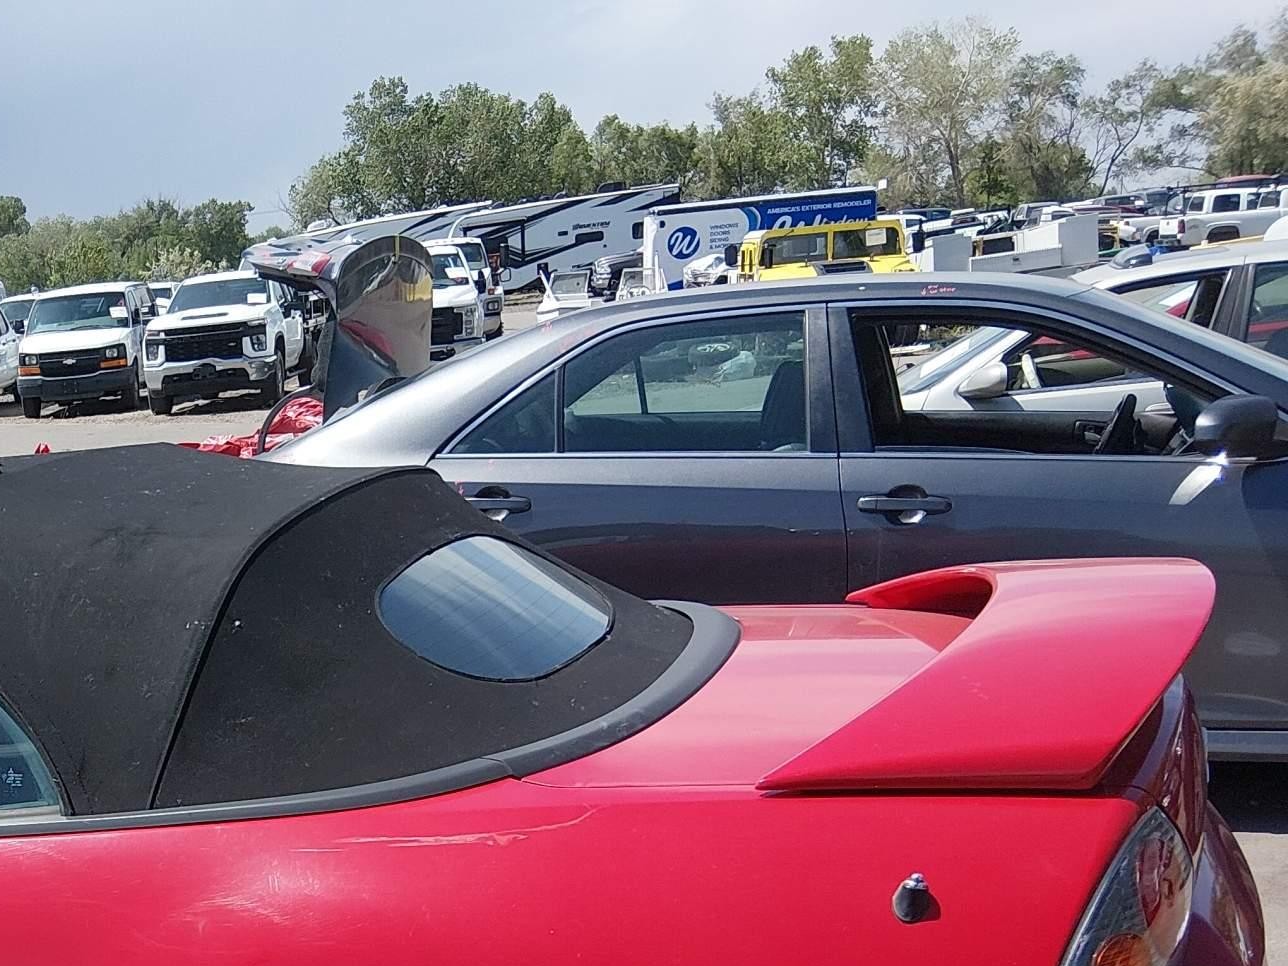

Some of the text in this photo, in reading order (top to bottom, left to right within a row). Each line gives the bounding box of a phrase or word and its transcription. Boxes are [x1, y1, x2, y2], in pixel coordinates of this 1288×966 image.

[767, 199, 872, 214] AMERICA'S EXTERIOR REMODELER
